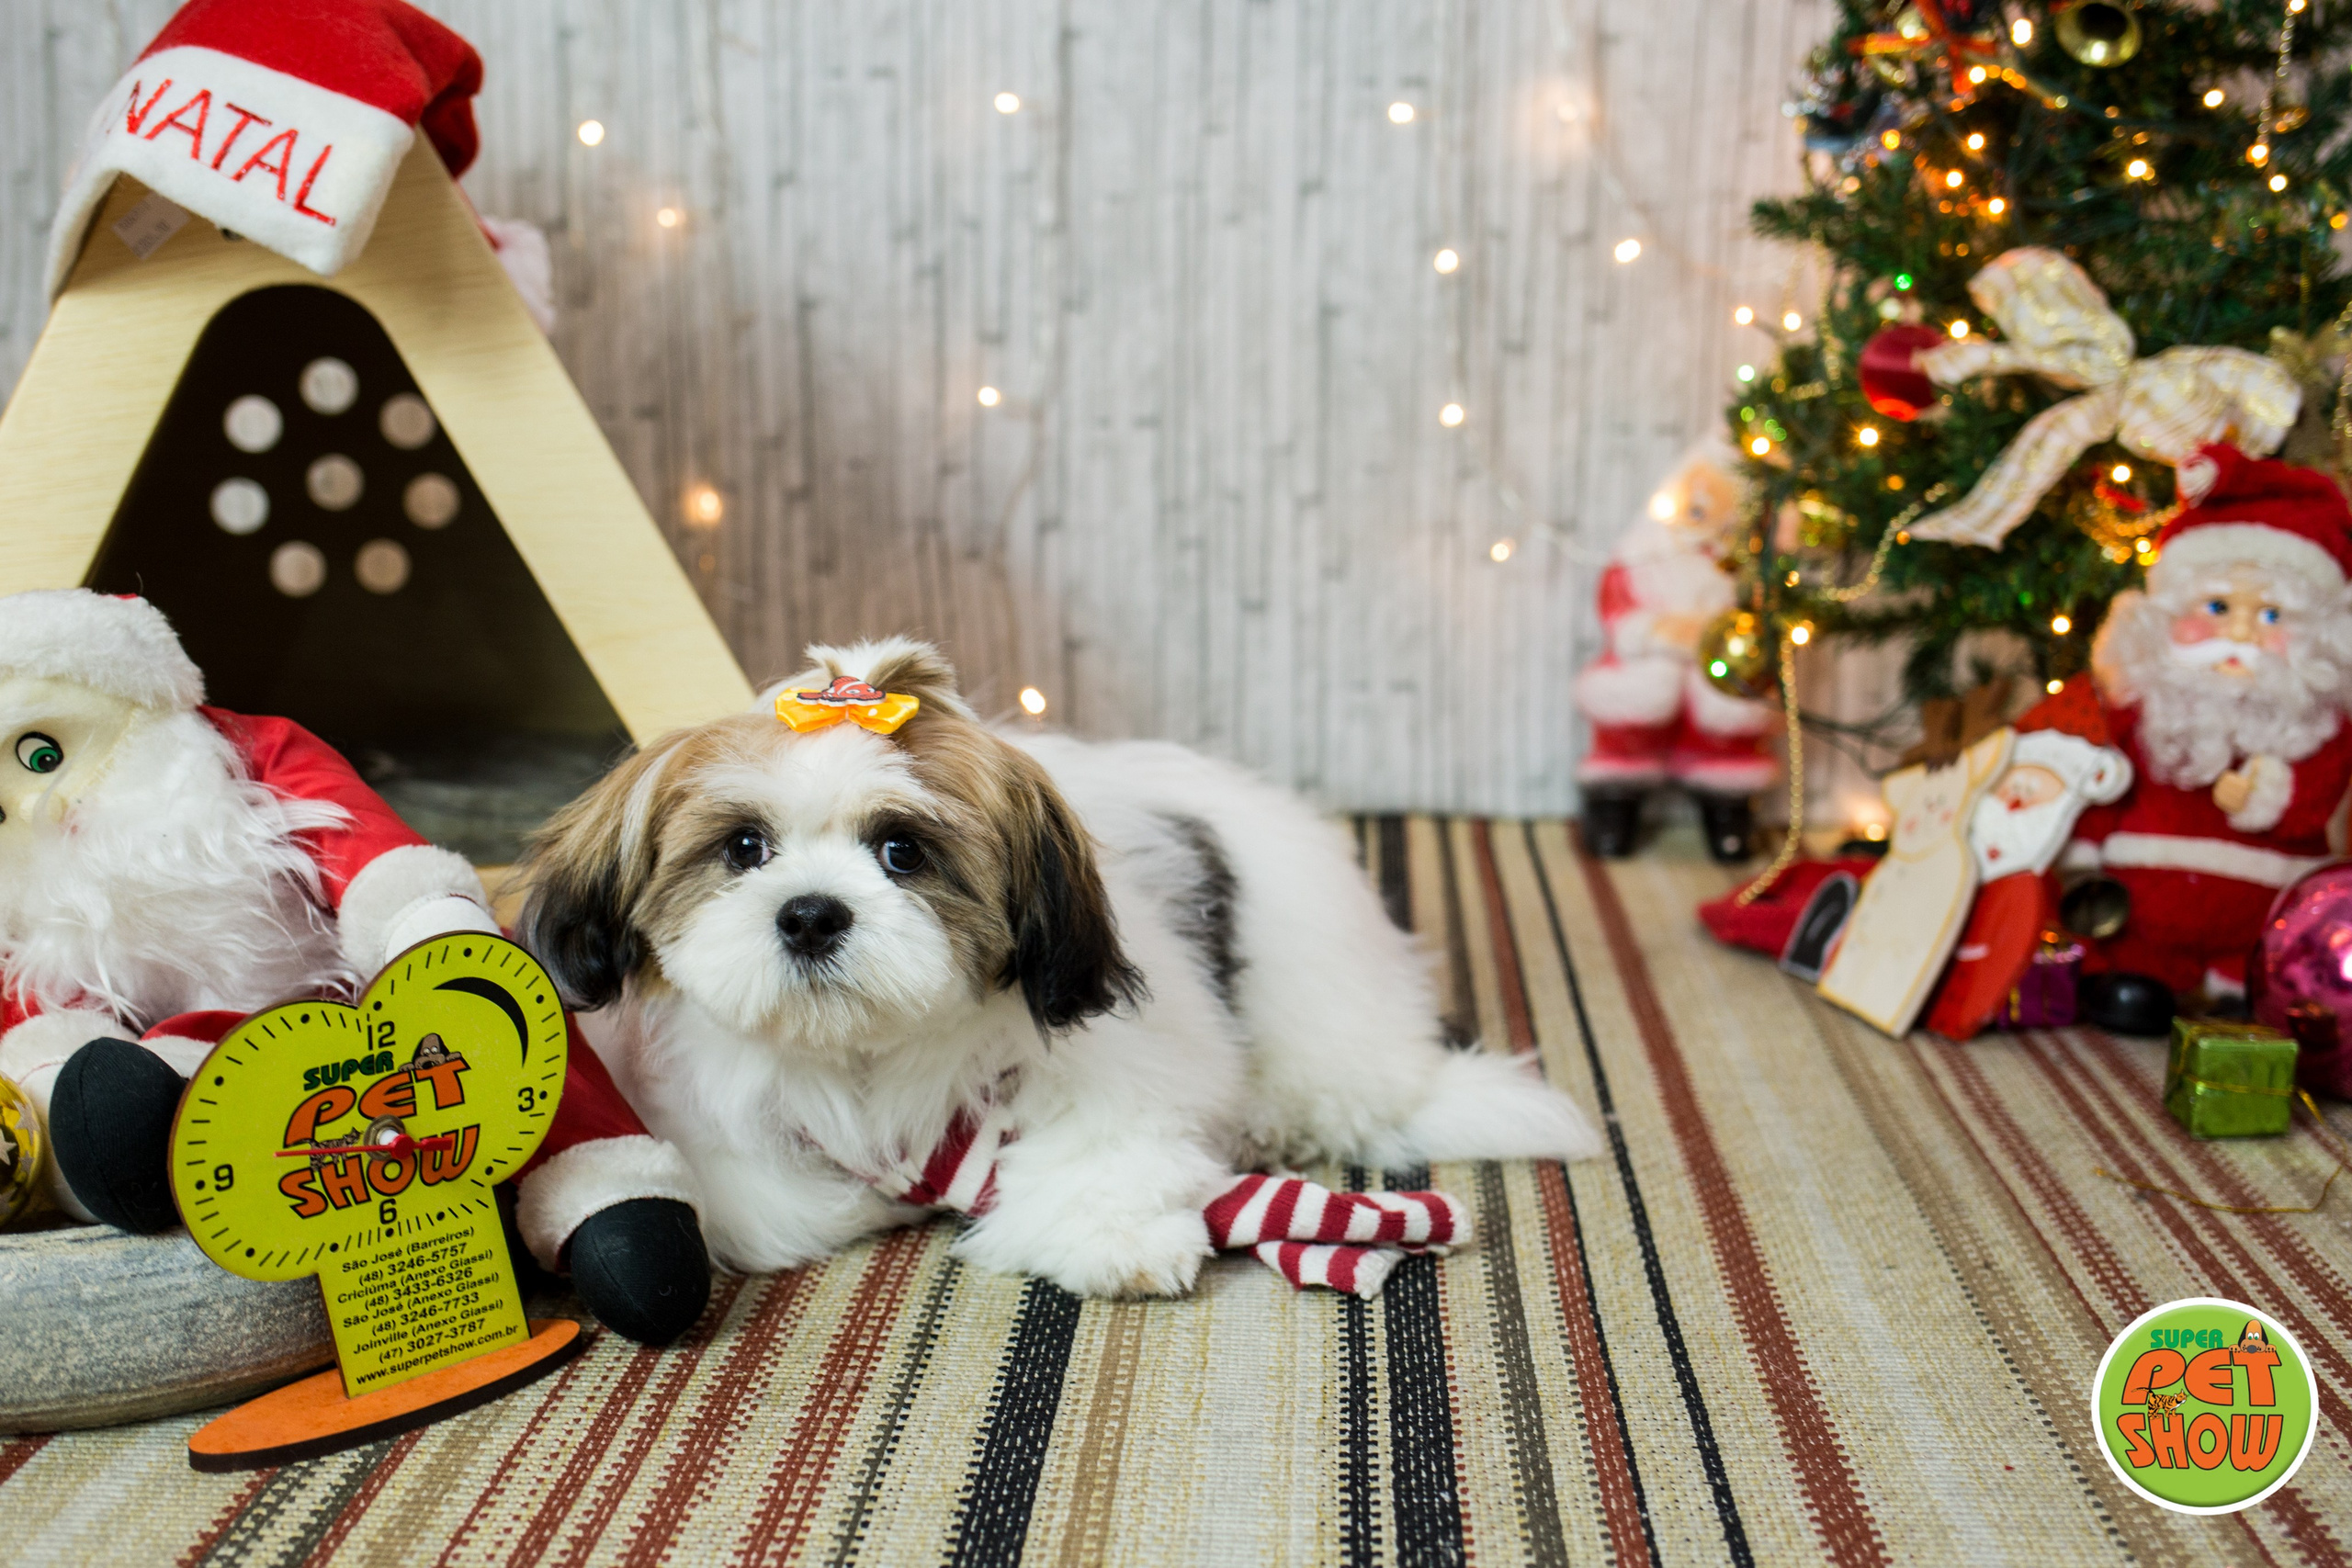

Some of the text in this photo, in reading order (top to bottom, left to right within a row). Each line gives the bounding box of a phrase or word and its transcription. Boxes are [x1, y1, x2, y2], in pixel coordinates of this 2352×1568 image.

[110, 77, 337, 228] NATAL
[368, 1021, 396, 1051] 12
[303, 1051, 395, 1091] SUPER
[283, 1057, 471, 1148] PET
[517, 1087, 536, 1113] 3
[214, 1164, 234, 1192] 9
[278, 1123, 481, 1220] SHOW
[379, 1198, 398, 1225] 6
[342, 1225, 474, 1273] São José (Barreiros)
[359, 1242, 468, 1286] (48) 3246-5757
[401, 1265, 447, 1287] (Anexo
[449, 1248, 493, 1269] Giassi)
[343, 1271, 500, 1328] São José (Anexo Giassi)
[365, 1266, 473, 1312] (48) 3433-6326
[353, 1298, 503, 1355] Joinville (Anexo Giassi)
[372, 1292, 480, 1337] (48) 3246-7733
[356, 1325, 519, 1385] www.superpetshow.com.br
[379, 1317, 486, 1364] (47) 3027-3787
